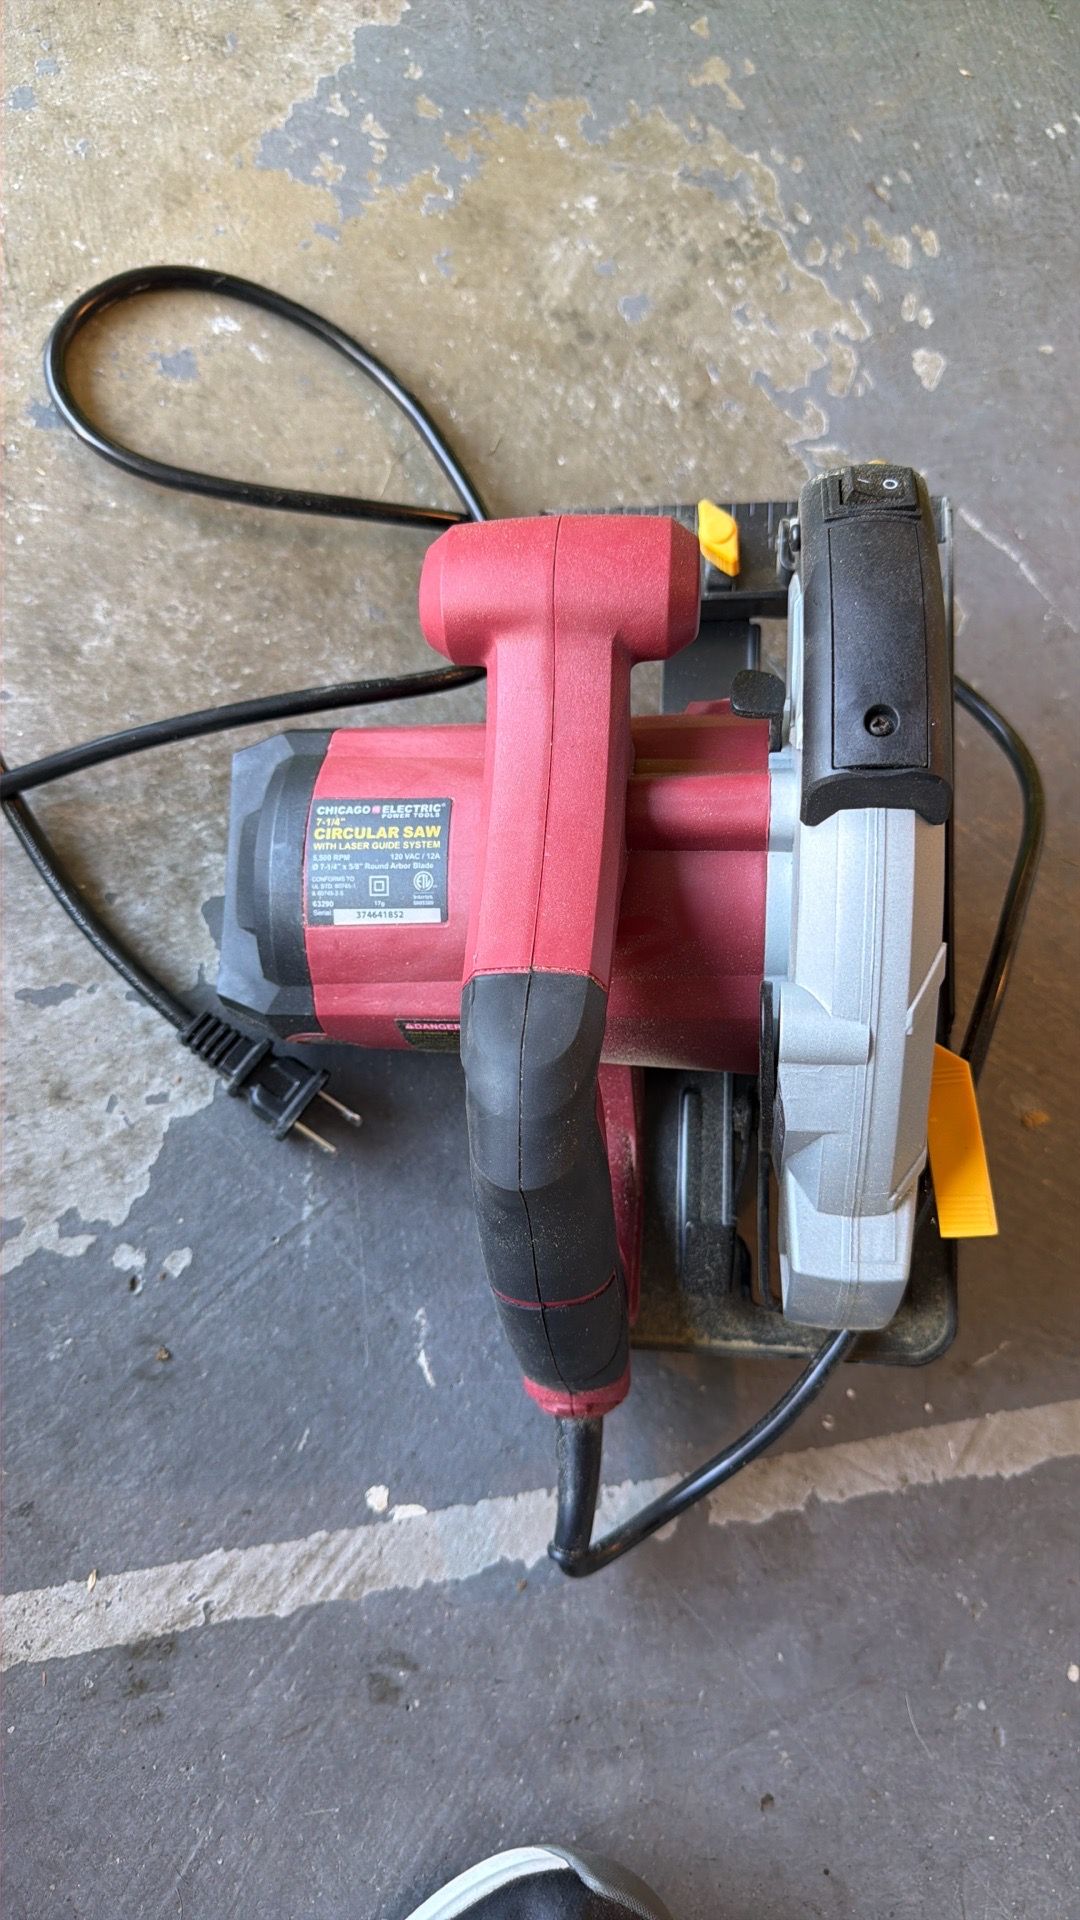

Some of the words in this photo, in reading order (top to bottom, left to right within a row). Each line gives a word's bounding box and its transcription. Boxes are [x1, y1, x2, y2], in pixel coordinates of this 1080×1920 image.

[316, 805, 371, 815] CHICAGO
[382, 803, 441, 814] ELECTRIC
[316, 818, 346, 826] 7-1/4"
[314, 826, 399, 840] CIRCULAR
[403, 825, 441, 838] SAW
[313, 842, 337, 850] WITH
[339, 842, 370, 850] LASER
[372, 841, 400, 850] GUIDE
[403, 840, 441, 849] SYSTEM
[404, 852, 420, 860] VAC
[426, 852, 440, 860] 12A
[364, 862, 388, 870] Round
[390, 862, 411, 870] Arbor
[412, 861, 434, 869] Blade
[356, 910, 404, 919] 374641852
